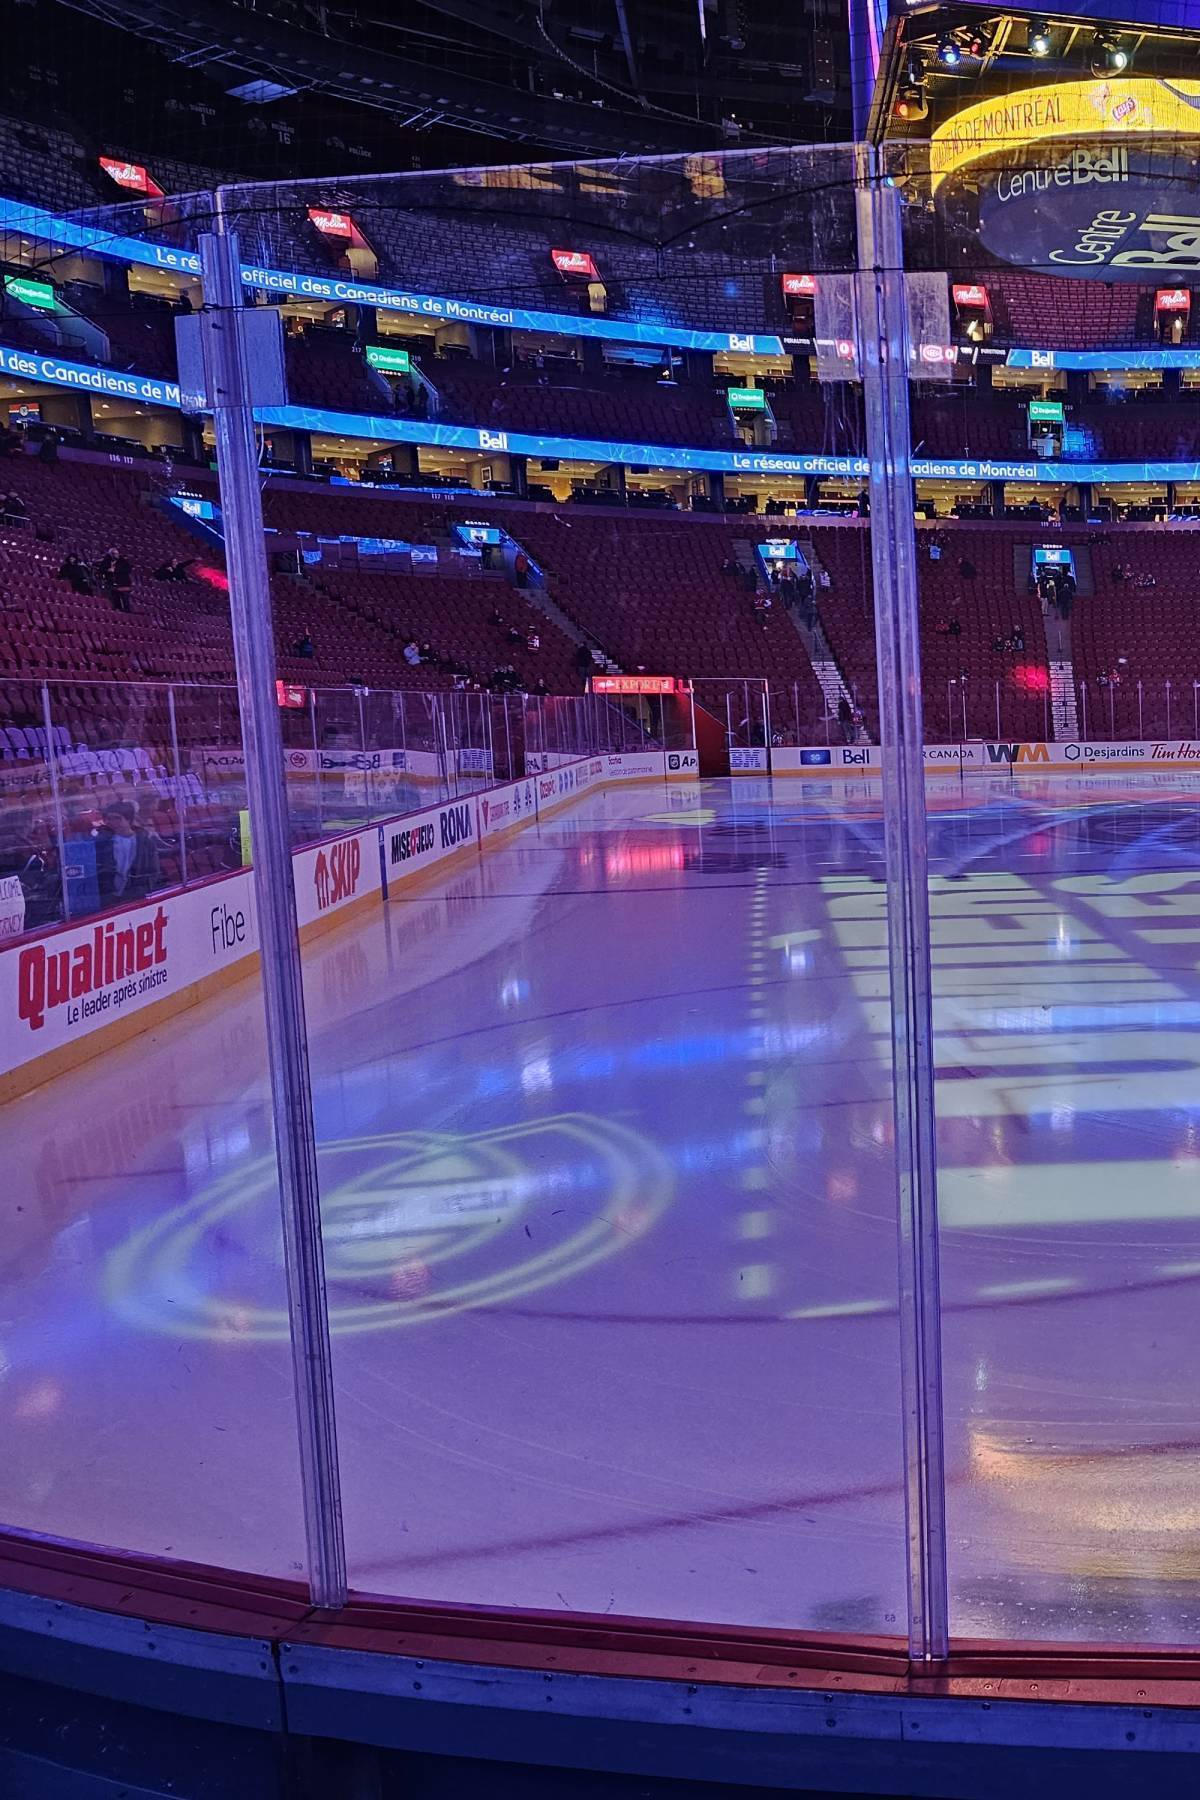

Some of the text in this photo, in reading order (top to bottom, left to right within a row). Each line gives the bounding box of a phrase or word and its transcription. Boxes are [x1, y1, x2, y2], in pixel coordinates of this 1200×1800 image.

[983, 97, 1065, 136] MONTRÉAL
[1048, 210, 1137, 266] Centre
[156, 249, 175, 264] Le
[242, 270, 513, 323] officiel des Canadiens de Montréal
[729, 334, 754, 351] Bell
[1031, 350, 1054, 367] Bell
[9, 358, 38, 376] des
[41, 361, 138, 394] Canadiens
[141, 384, 162, 401] de
[479, 430, 508, 450] Bell
[733, 455, 1037, 477] Le réseau officiel de Montréal
[681, 755, 698, 768] Ap
[842, 749, 870, 765] Bell
[929, 750, 974, 759] CANADA
[986, 743, 1050, 763] WM
[1084, 746, 1145, 759] Desjardins
[1150, 743, 1176, 759] Tim
[439, 803, 473, 849] RONA
[329, 838, 361, 904] SKIP
[210, 903, 246, 954] Fibe
[19, 906, 169, 1031] Qualinet
[67, 967, 168, 1026] Le leader après sinistre
